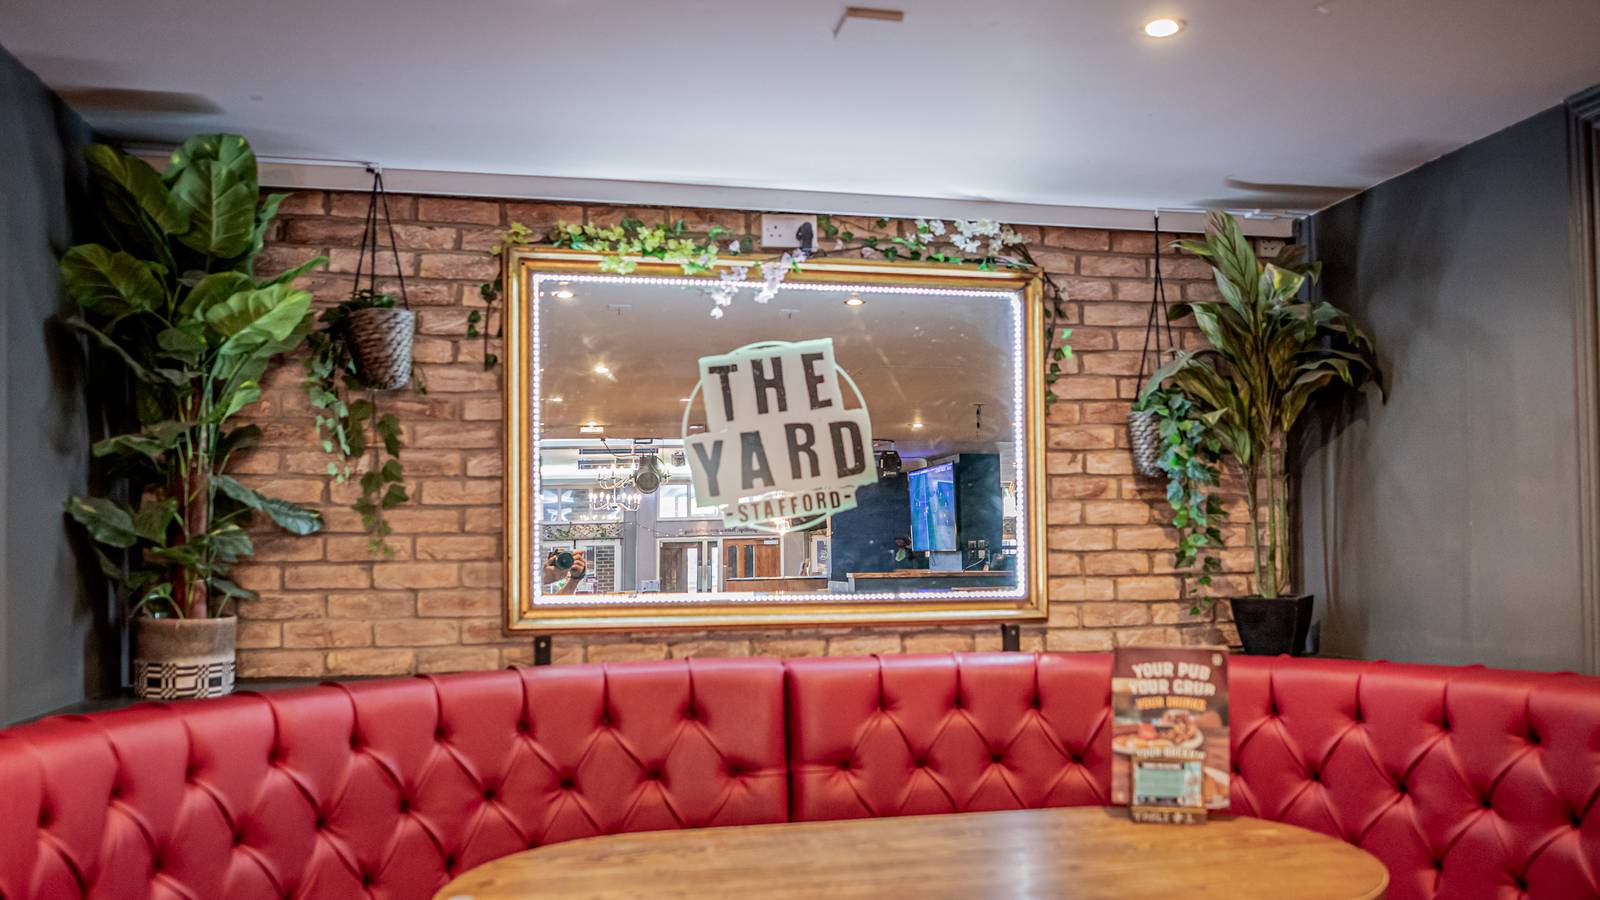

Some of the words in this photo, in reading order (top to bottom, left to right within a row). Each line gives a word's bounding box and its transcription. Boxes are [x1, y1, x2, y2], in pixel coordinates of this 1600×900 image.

[708, 352, 833, 422] THE
[692, 421, 866, 497] YARD
[1130, 679, 1169, 695] YOUR
[1131, 662, 1174, 679] YOUR
[1178, 662, 1211, 680] PUB
